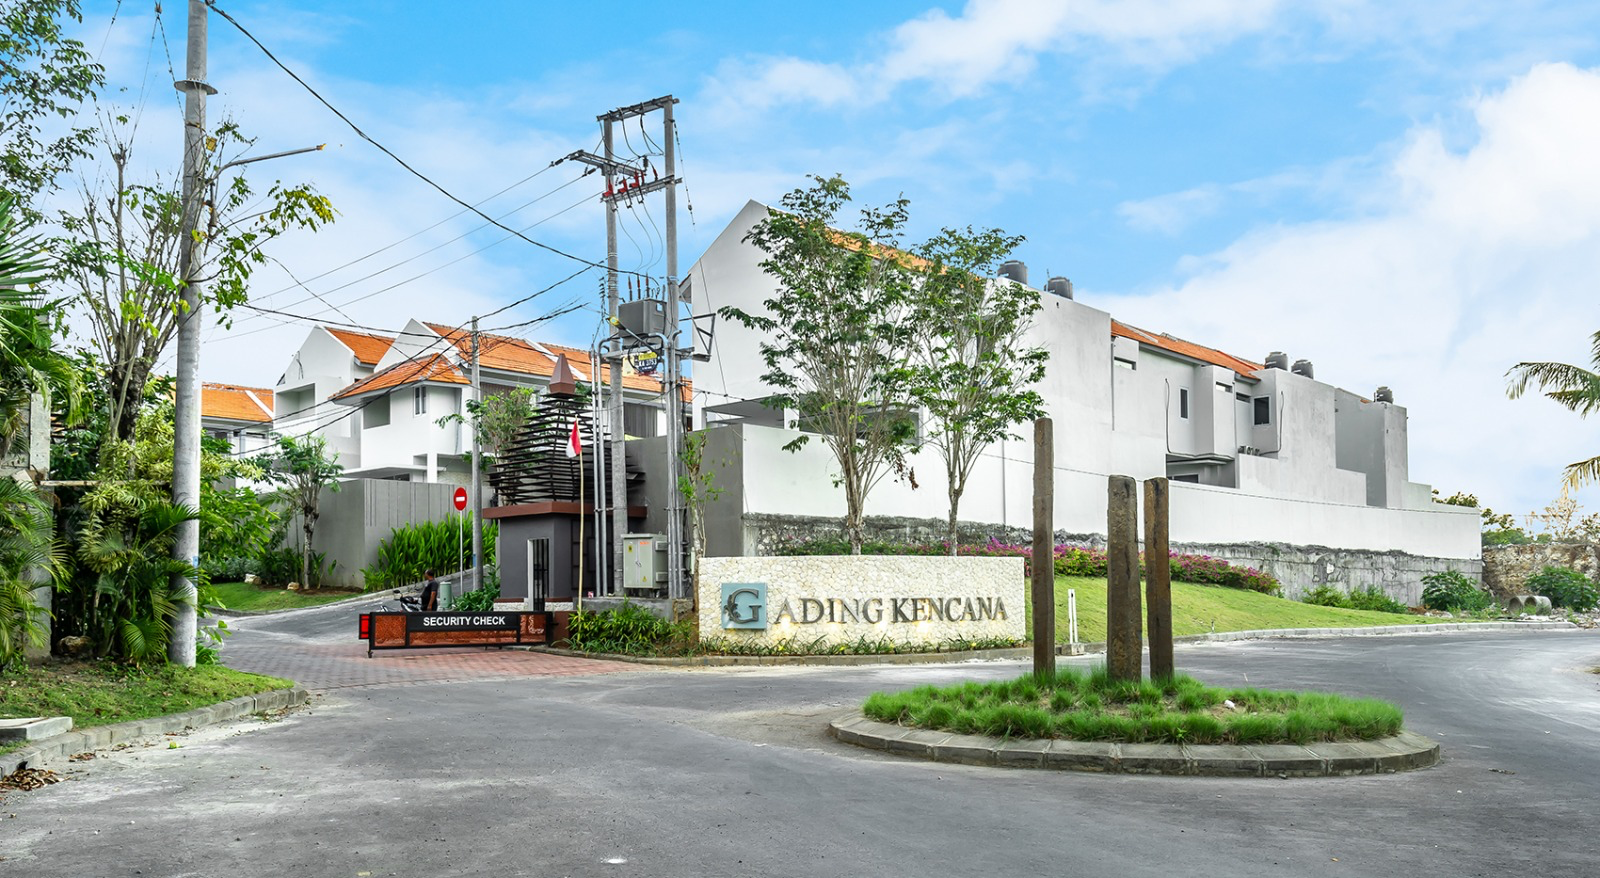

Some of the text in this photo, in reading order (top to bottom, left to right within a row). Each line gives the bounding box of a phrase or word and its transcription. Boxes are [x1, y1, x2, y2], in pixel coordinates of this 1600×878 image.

[890, 597, 1009, 623] KENCANA
[423, 616, 506, 626] SECURITY CHECK
